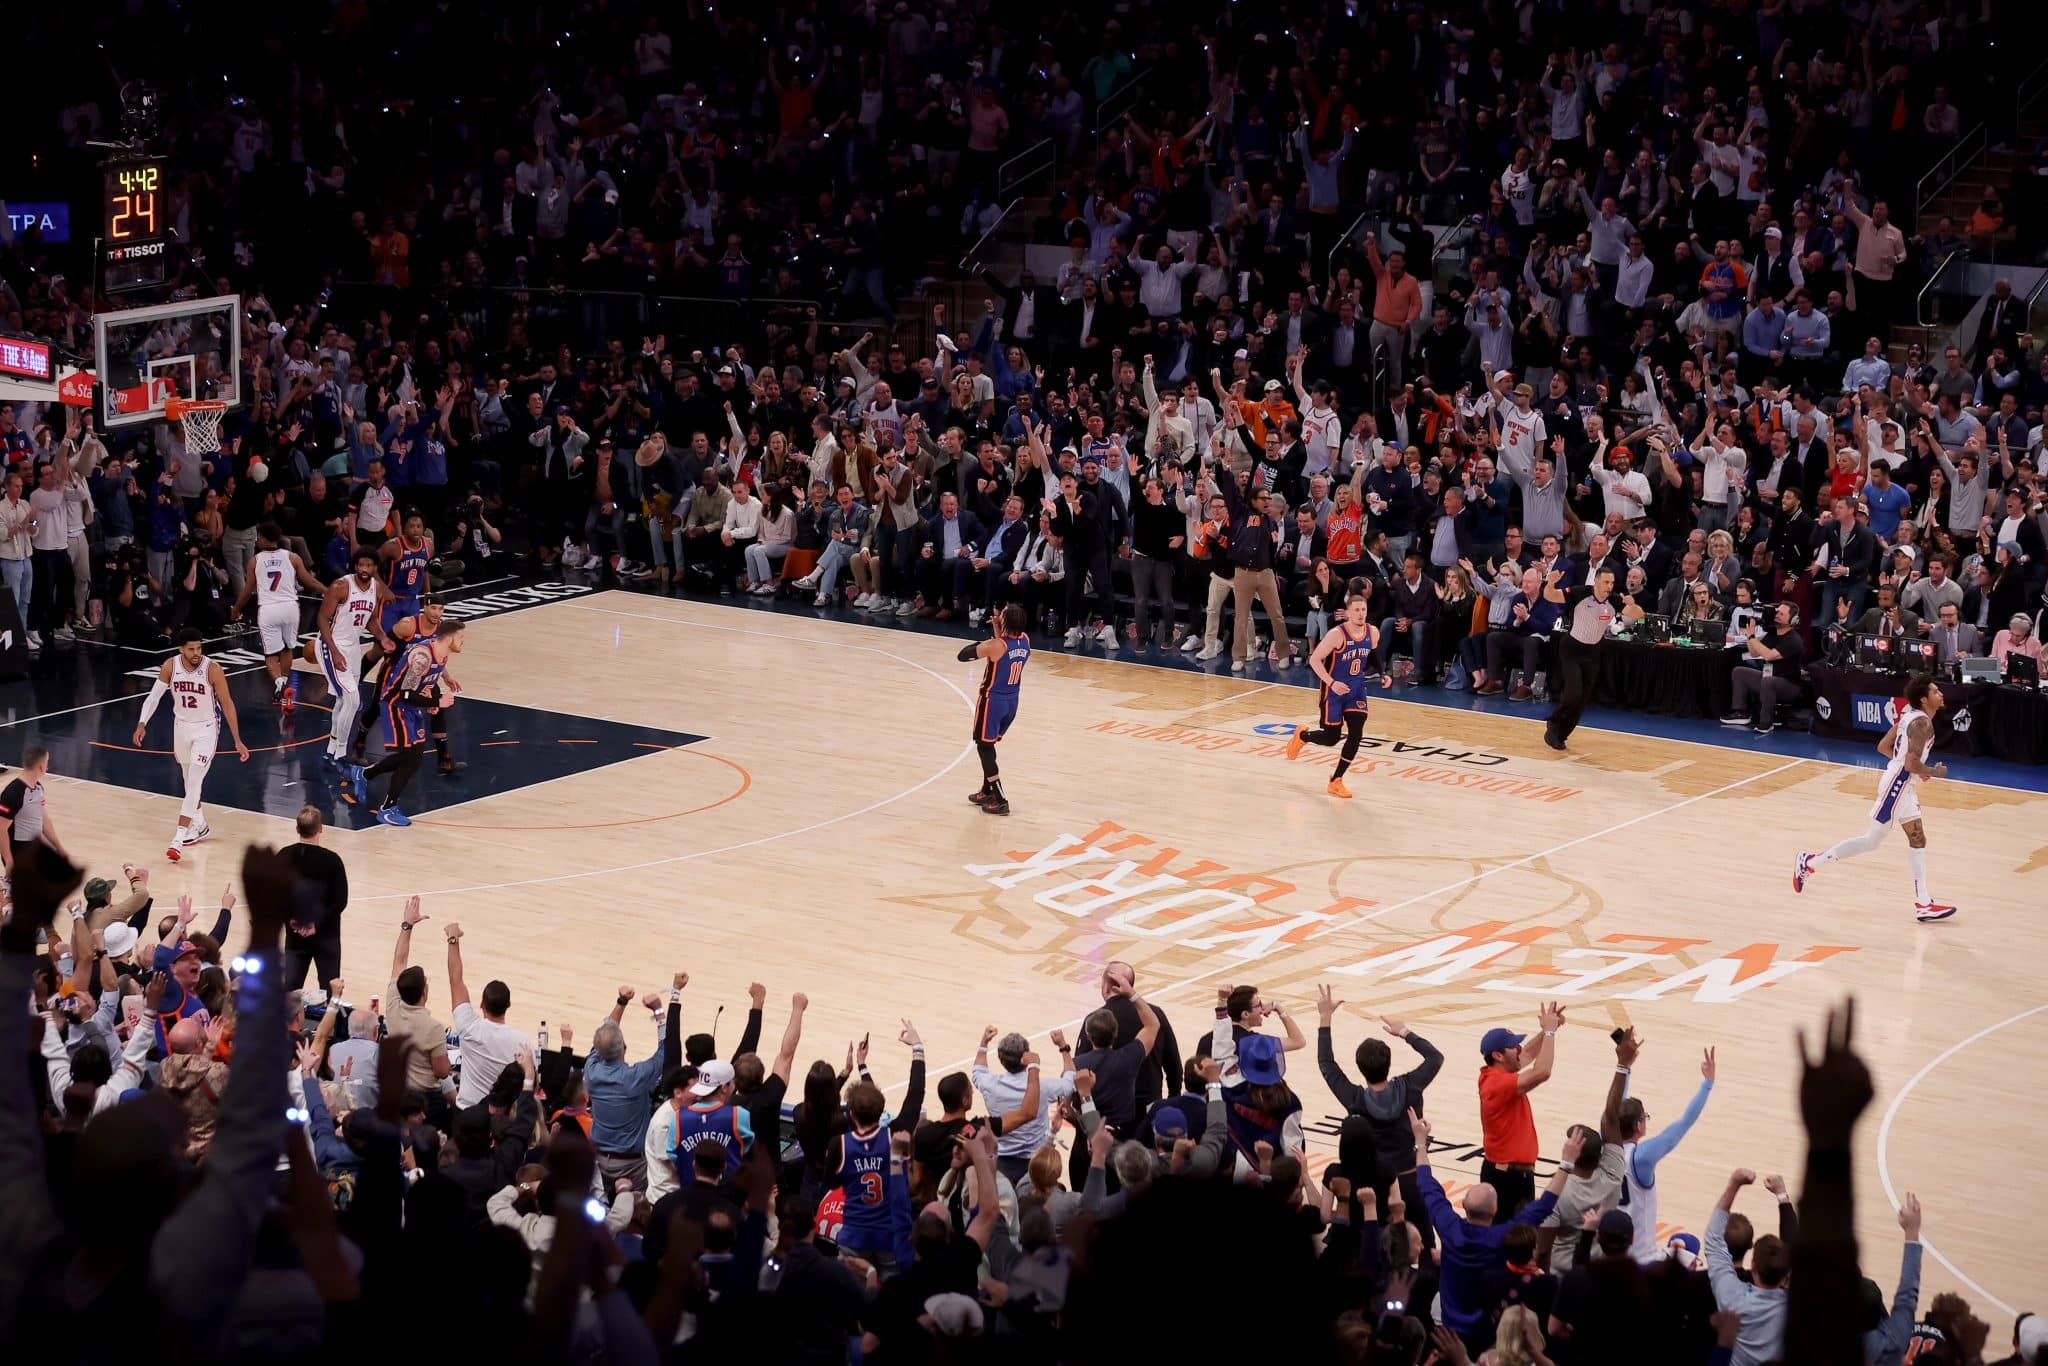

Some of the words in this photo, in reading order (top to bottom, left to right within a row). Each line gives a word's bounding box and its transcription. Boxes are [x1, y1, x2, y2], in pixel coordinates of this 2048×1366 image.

[119, 167, 158, 194] 4:42
[111, 192, 154, 238] 24
[124, 242, 165, 259] TISSOT
[4, 345, 21, 368] THE
[29, 349, 47, 376] App
[77, 383, 92, 399] Sta
[1509, 431, 1520, 446] 5
[400, 558, 414, 570] NEW
[267, 570, 282, 592] 7
[407, 568, 418, 586] 8
[349, 599, 375, 614] PHILA
[440, 582, 593, 621] NICKS
[353, 613, 365, 627] 21
[1341, 649, 1356, 661] NEW
[1008, 661, 1023, 685] 11
[1349, 658, 1361, 676] 0
[173, 681, 205, 695] PHILA
[181, 696, 198, 709] 12
[1857, 701, 1882, 725] NBA
[1085, 719, 1244, 751] GARDEN
[1389, 764, 1584, 803] MADISON
[963, 820, 1379, 959] YORK
[1324, 921, 1862, 1002] NEW
[700, 1072, 711, 1083] YC
[853, 1156, 884, 1173] HART
[860, 1171, 884, 1205] 3
[823, 1200, 844, 1215] CHE
